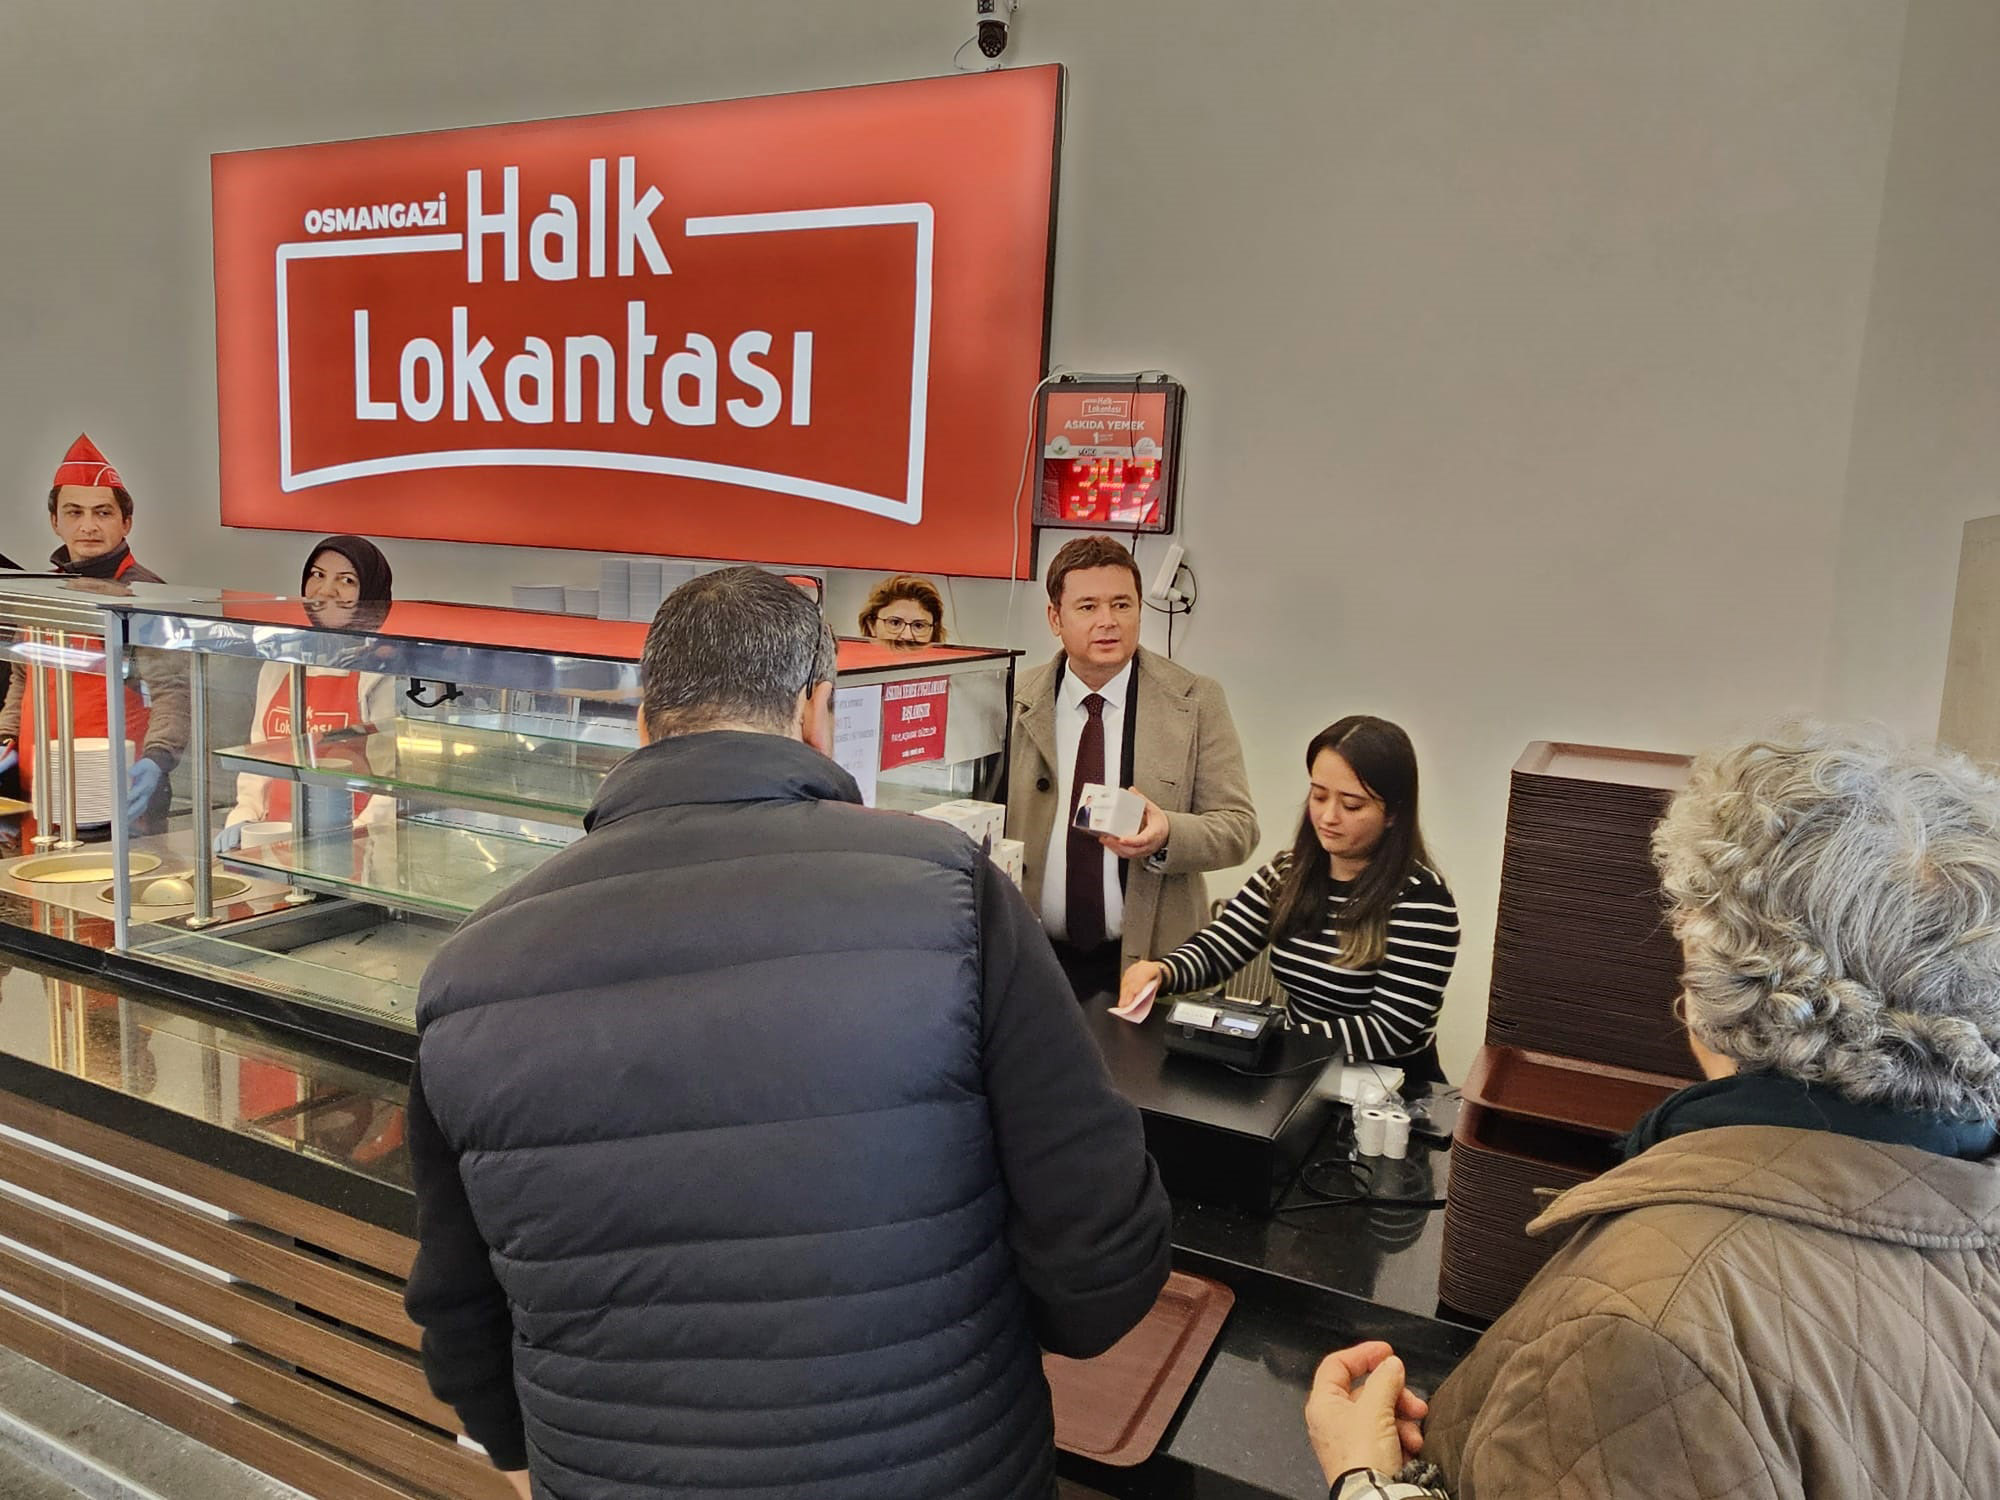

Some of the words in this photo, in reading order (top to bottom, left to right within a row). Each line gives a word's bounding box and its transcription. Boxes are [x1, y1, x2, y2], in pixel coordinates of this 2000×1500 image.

[304, 191, 448, 235] OSMANGAZİ
[466, 156, 673, 283] Halk
[354, 301, 813, 427] Lokantası
[1064, 420, 1104, 430] ASKIDA
[1107, 420, 1145, 431] YEMEK
